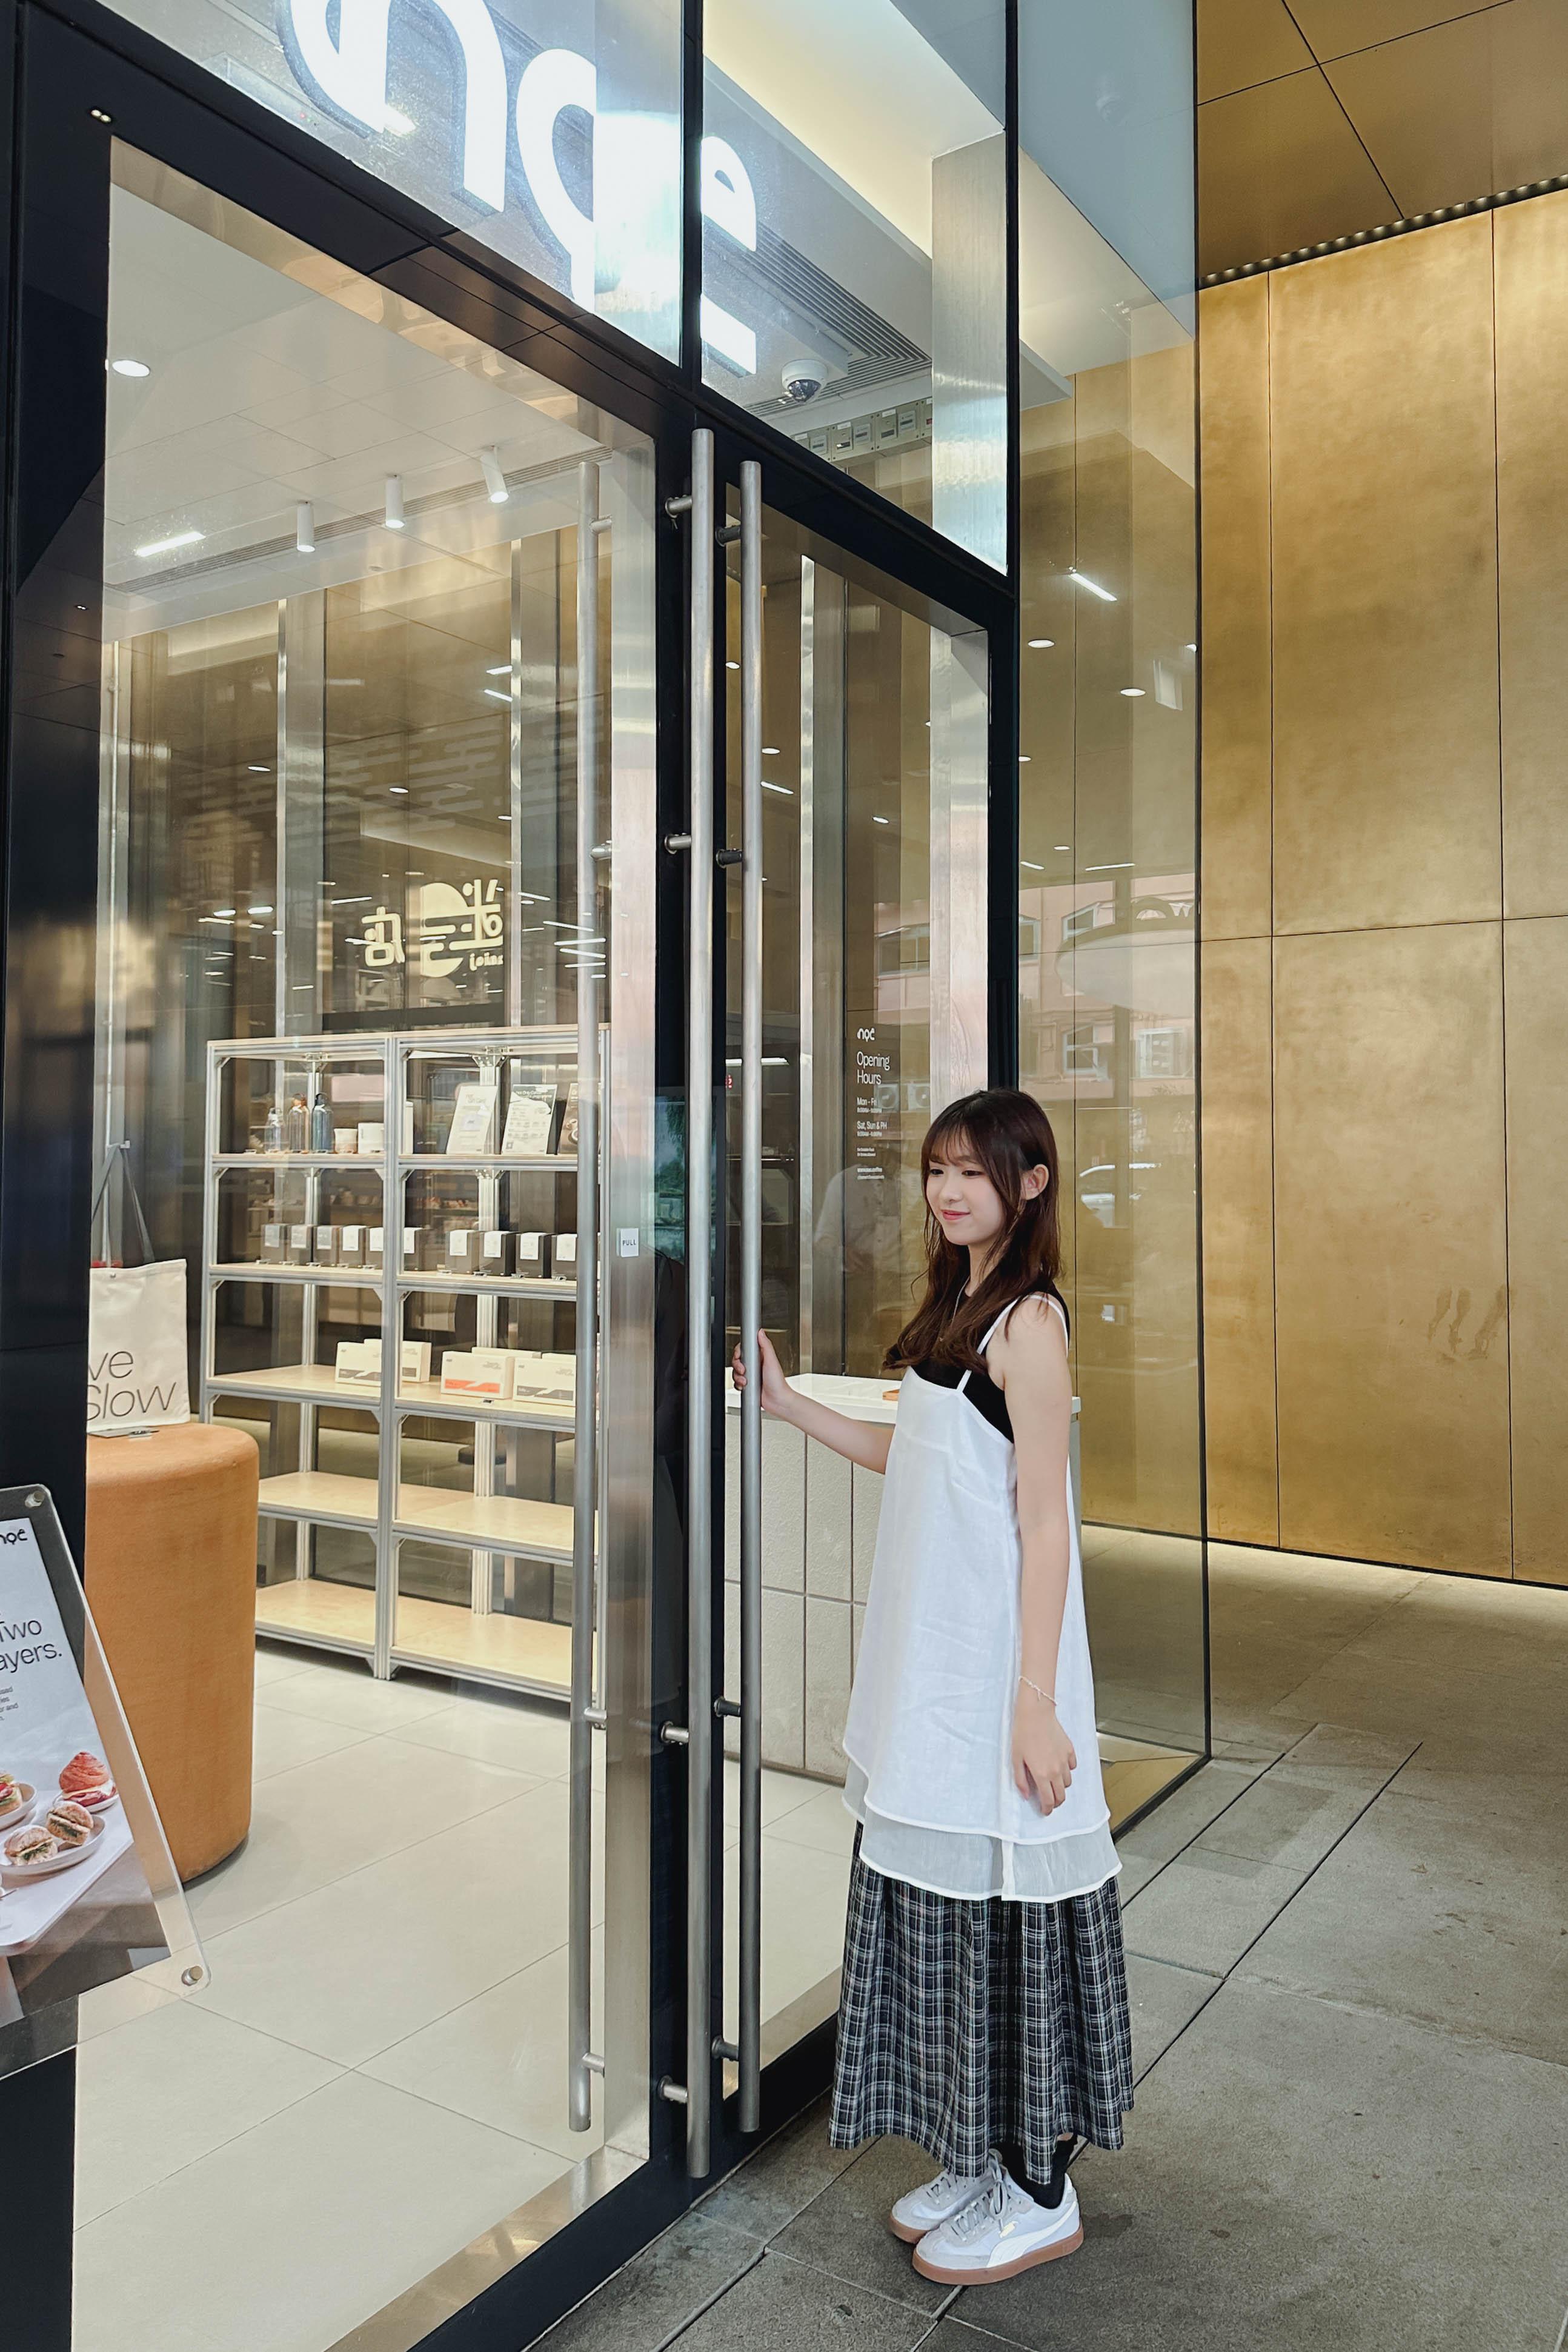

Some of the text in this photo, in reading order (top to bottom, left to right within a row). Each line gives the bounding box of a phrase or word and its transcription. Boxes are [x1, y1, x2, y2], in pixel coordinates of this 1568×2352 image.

[857, 1051, 890, 1071] Opening
[857, 1069, 882, 1085] Hours
[857, 1097, 868, 1106] Mon
[857, 1121, 866, 1131] Sat,
[866, 1121, 876, 1130] Sun
[880, 1121, 888, 1129] PH
